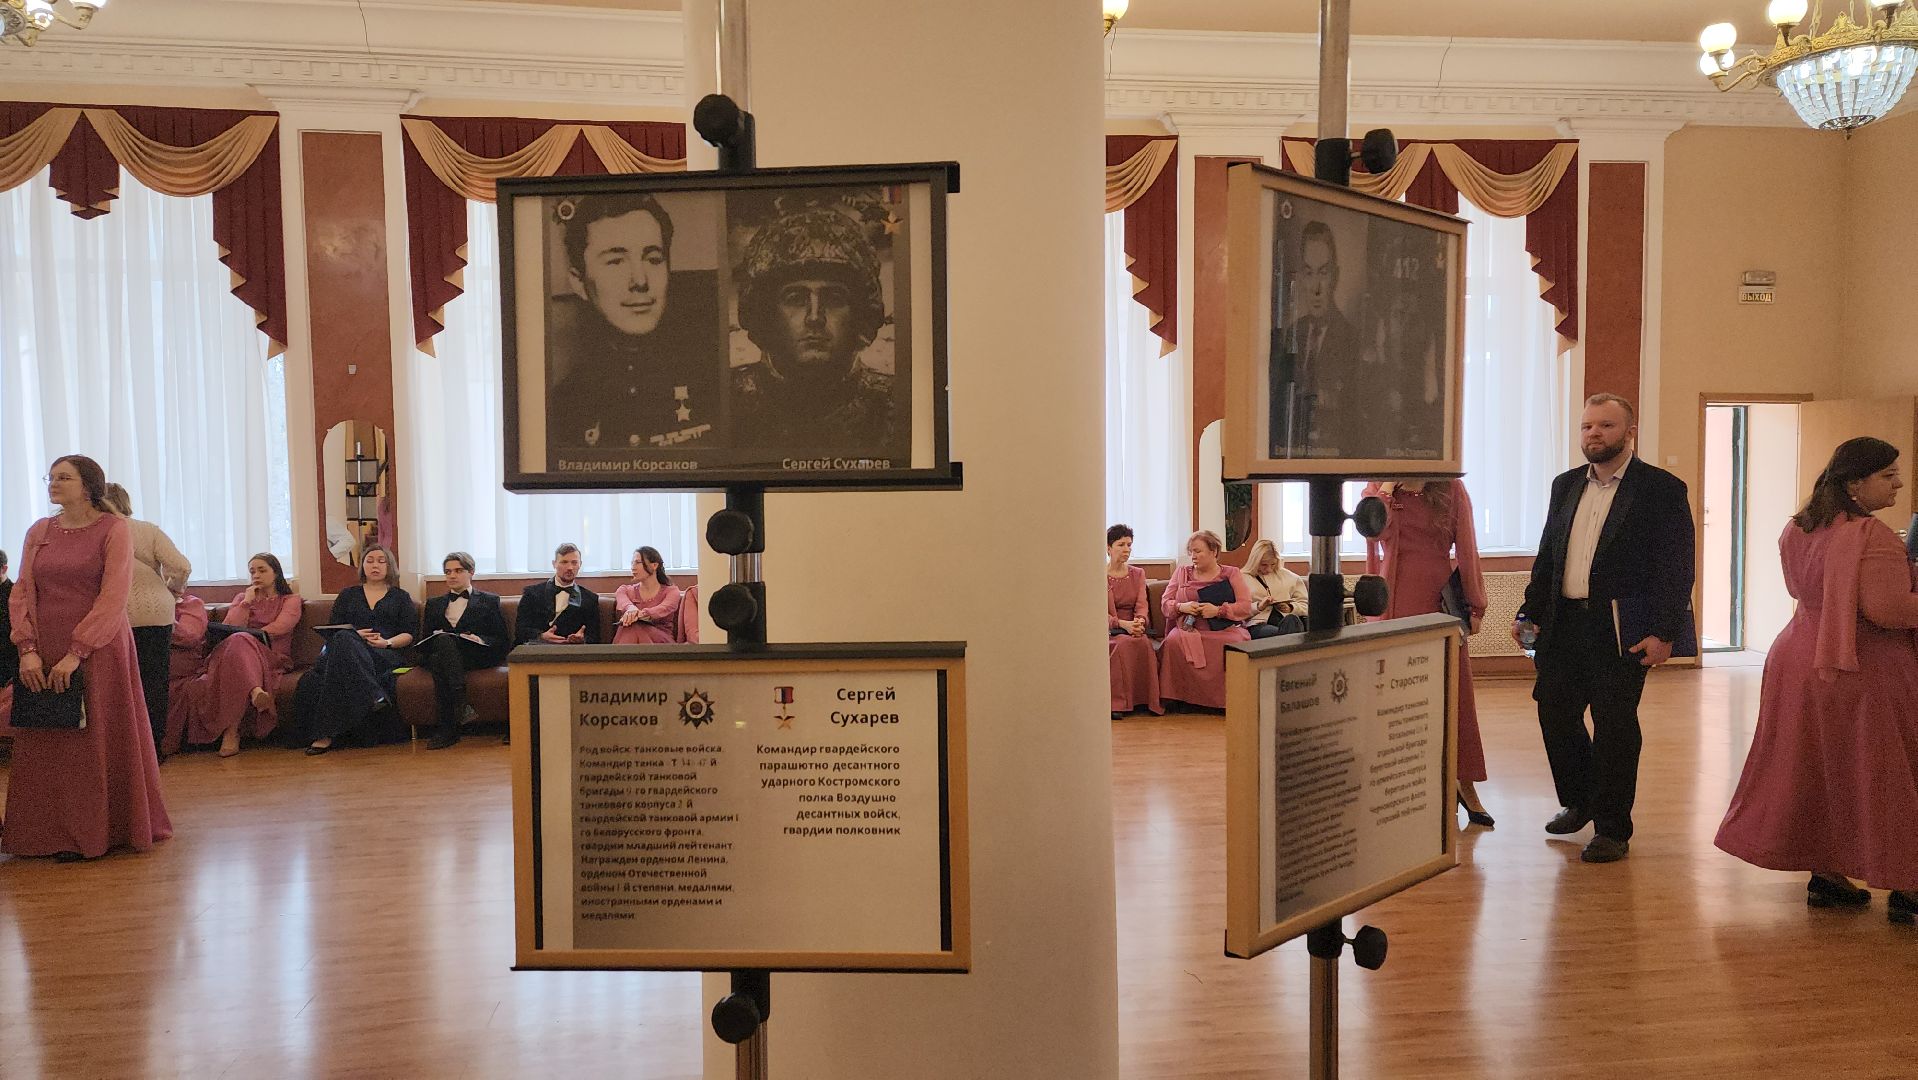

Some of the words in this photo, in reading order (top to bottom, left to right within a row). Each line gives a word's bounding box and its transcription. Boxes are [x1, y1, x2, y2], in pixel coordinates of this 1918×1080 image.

[1742, 292, 1772, 302] ВЫХОД
[558, 459, 631, 472] Владимир
[633, 459, 698, 472] Корсаков
[782, 457, 831, 470] Сергей
[833, 458, 890, 470] Сухарев
[1390, 674, 1428, 690] Старостин
[579, 690, 668, 706] Владимир
[836, 686, 896, 704] Сергей
[579, 713, 659, 730] Корсаков
[830, 711, 900, 728] Сухарев
[634, 745, 684, 753] танковые
[757, 744, 817, 755] Командир
[819, 744, 900, 755] гвардейского
[579, 759, 632, 770] Командир
[832, 761, 900, 772] десантного
[579, 772, 646, 783] гвардейской
[648, 771, 697, 781] танковой
[761, 778, 816, 789] ударного
[818, 776, 901, 788] Костромского
[579, 786, 625, 797] бригады
[648, 785, 718, 796] гвардейского
[799, 794, 834, 803] полка
[836, 793, 896, 804] Воздушно
[580, 800, 633, 810] танкового
[635, 800, 676, 810] корпуса
[579, 813, 647, 824] гвардейской
[649, 813, 698, 822] танковой
[700, 815, 734, 823] армии
[796, 810, 860, 821] десантных
[863, 808, 901, 820] войск,
[593, 827, 662, 839] Белорусского
[783, 826, 833, 837] гвардии
[835, 826, 901, 835] полковник
[580, 843, 624, 851] гвардии
[626, 842, 676, 851] младший
[580, 855, 638, 865] Награжден
[640, 856, 685, 865] орденом
[580, 871, 626, 879] орденом
[628, 868, 707, 878] Отечественной
[580, 883, 615, 892] войны
[580, 898, 659, 907] иностранными
[661, 899, 713, 907] орденами
